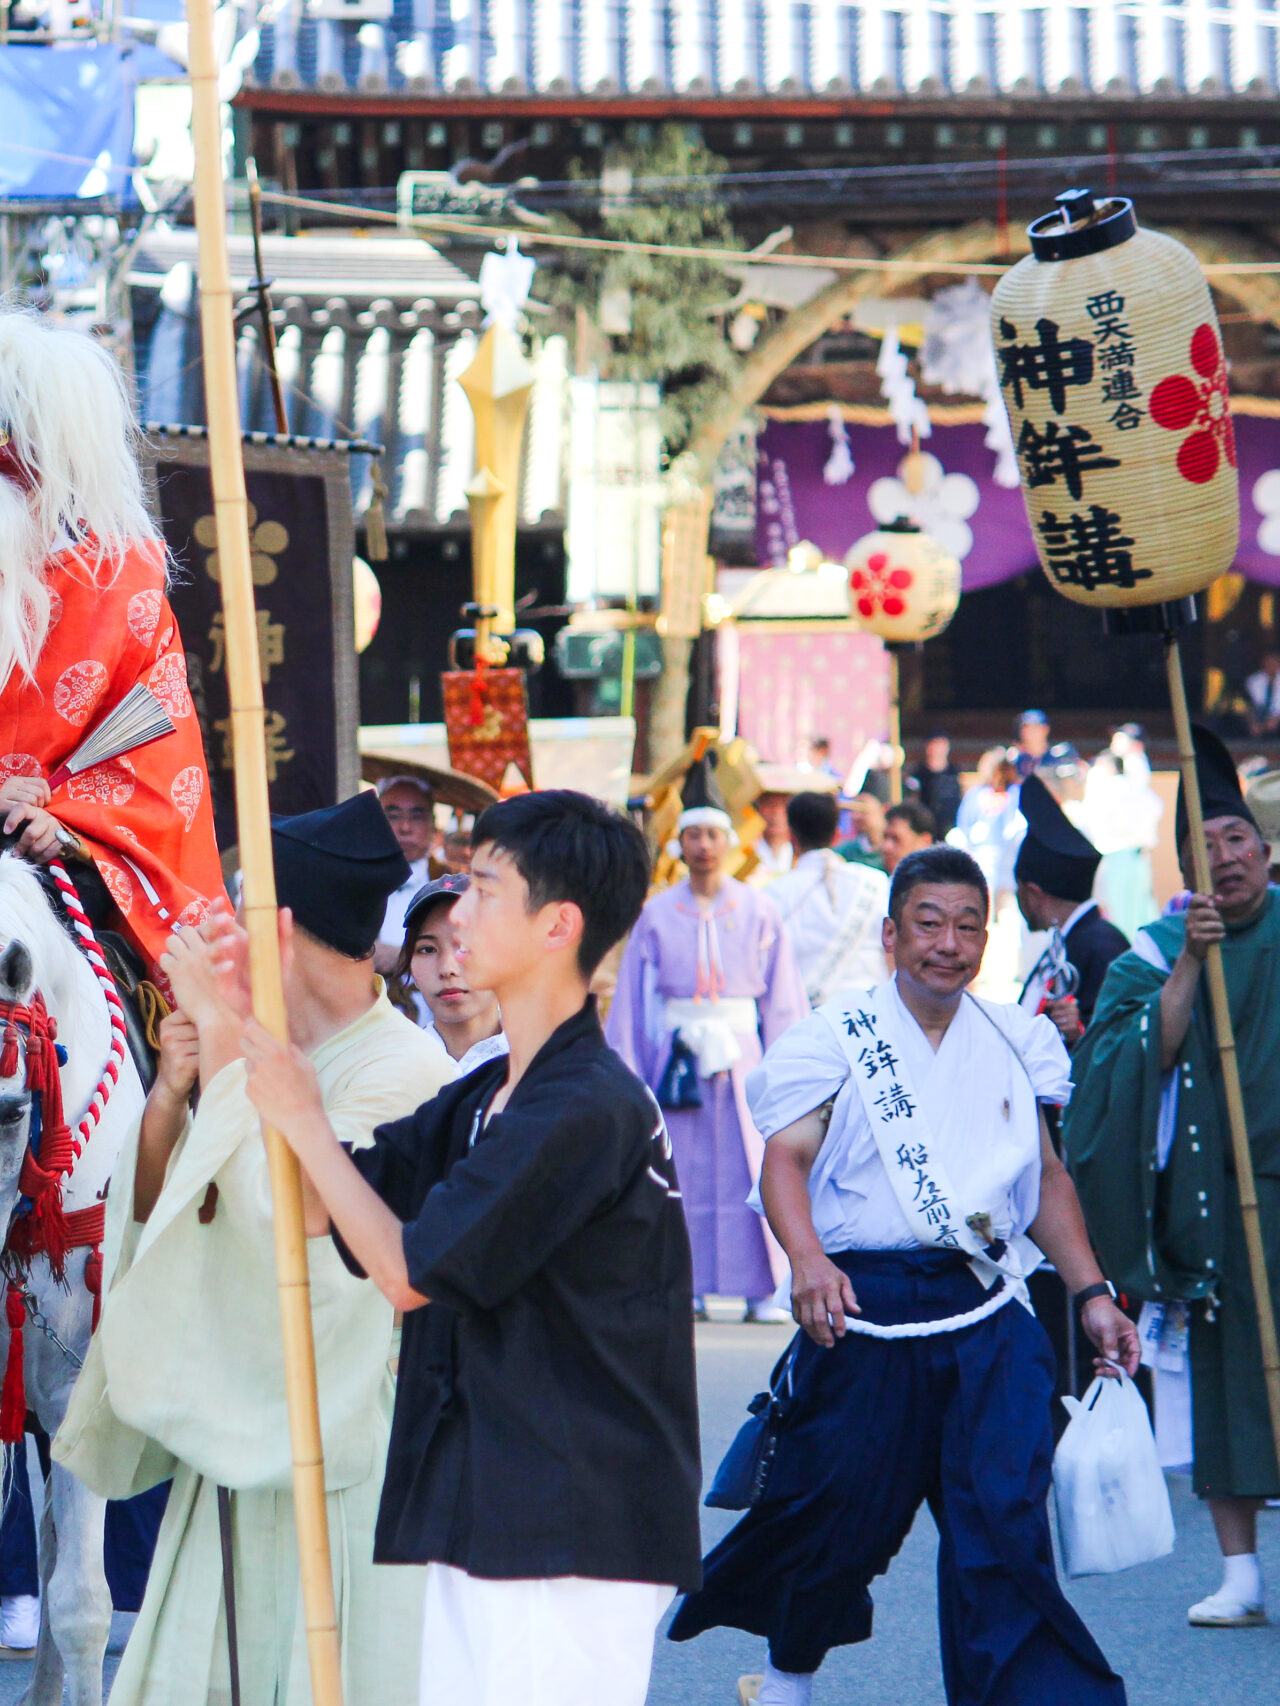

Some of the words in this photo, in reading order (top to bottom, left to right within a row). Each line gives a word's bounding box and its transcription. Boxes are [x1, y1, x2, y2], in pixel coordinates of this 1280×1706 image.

[1085, 290, 1147, 431] 西天満連合
[998, 315, 1153, 591] 神鉾講
[842, 1008, 917, 1123] 神鉾講
